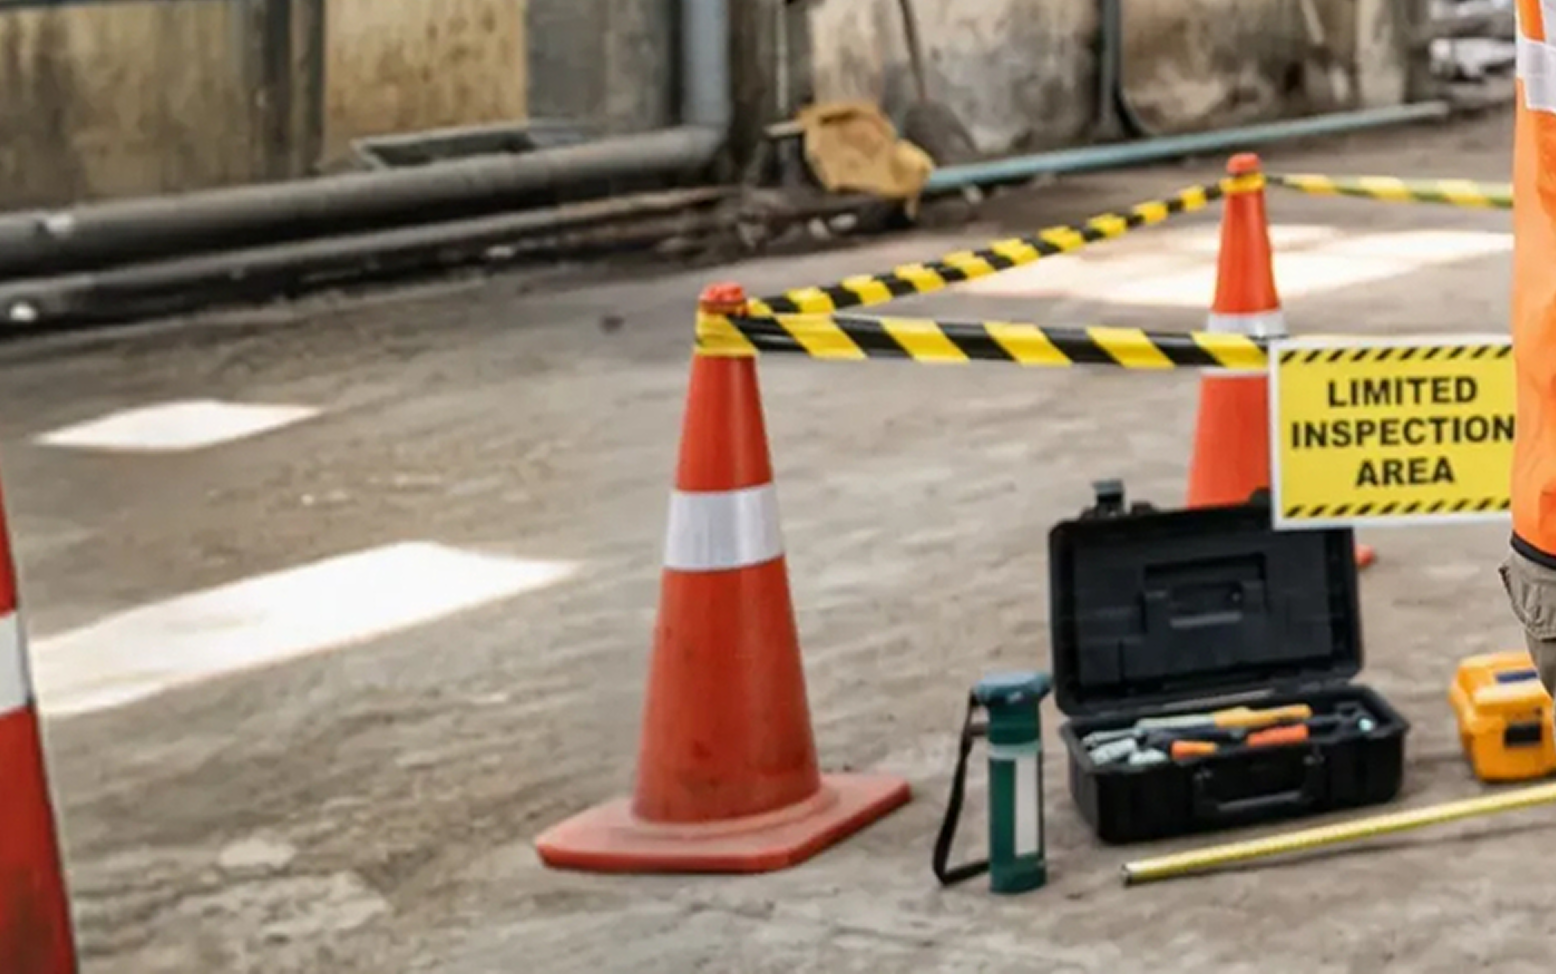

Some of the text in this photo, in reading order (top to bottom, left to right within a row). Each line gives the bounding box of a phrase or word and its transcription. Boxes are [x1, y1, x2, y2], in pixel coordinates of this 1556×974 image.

[1327, 376, 1477, 408] LIMITED
[1291, 415, 1515, 449] INSPECTION
[1355, 457, 1455, 488] AREA
